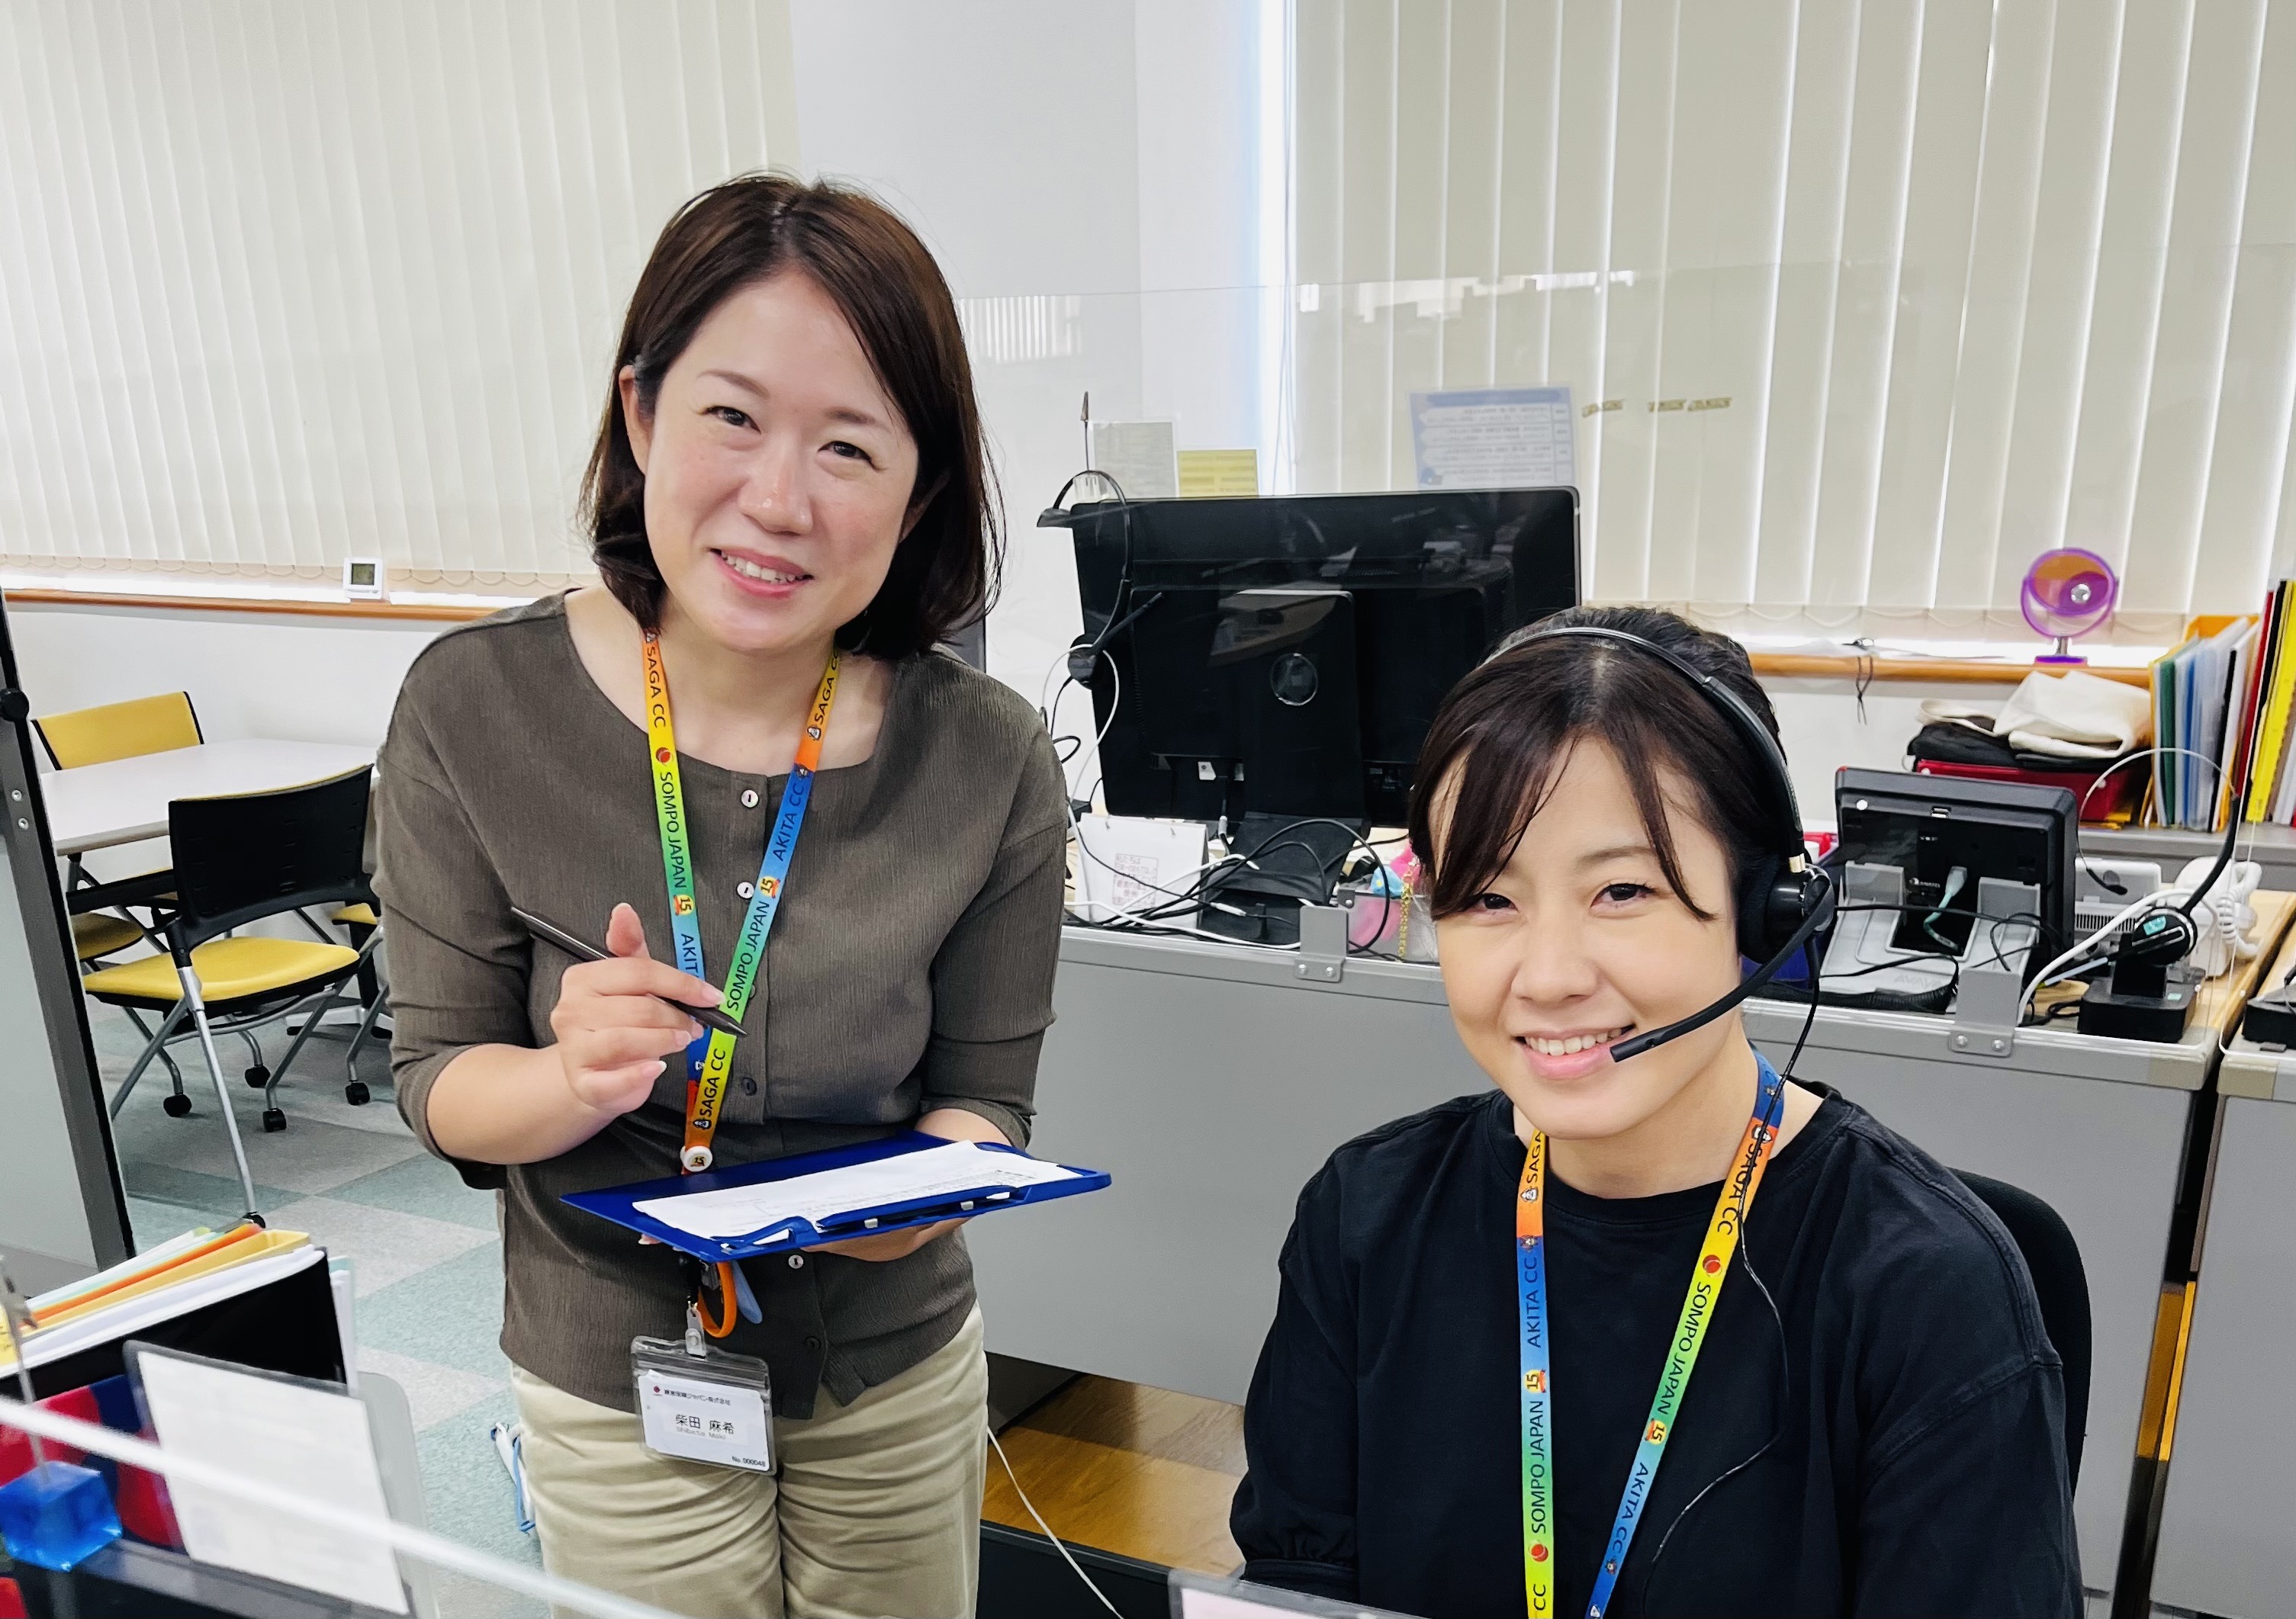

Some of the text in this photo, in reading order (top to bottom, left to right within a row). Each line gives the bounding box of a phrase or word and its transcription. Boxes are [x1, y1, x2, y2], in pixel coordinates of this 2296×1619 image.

[647, 646, 666, 728] SAGA CC
[815, 677, 834, 725] SAGA
[660, 772, 687, 888] SOMPO JAPAN
[773, 782, 806, 862] AKITA CC
[681, 933, 699, 978] AKIT
[727, 901, 770, 1012] SOMPO JAPAN
[699, 1048, 726, 1118] SAGA CC
[1526, 1130, 1542, 1184] SAGA
[1717, 1206, 1739, 1236] CC
[1525, 1256, 1542, 1348] AKITA CC
[1656, 1282, 1711, 1415] SOMPO JAPAN
[1529, 1400, 1546, 1534] SOMPO JAPAN
[1611, 1462, 1649, 1555] AKITA CC
[1533, 1582, 1547, 1611] CC
